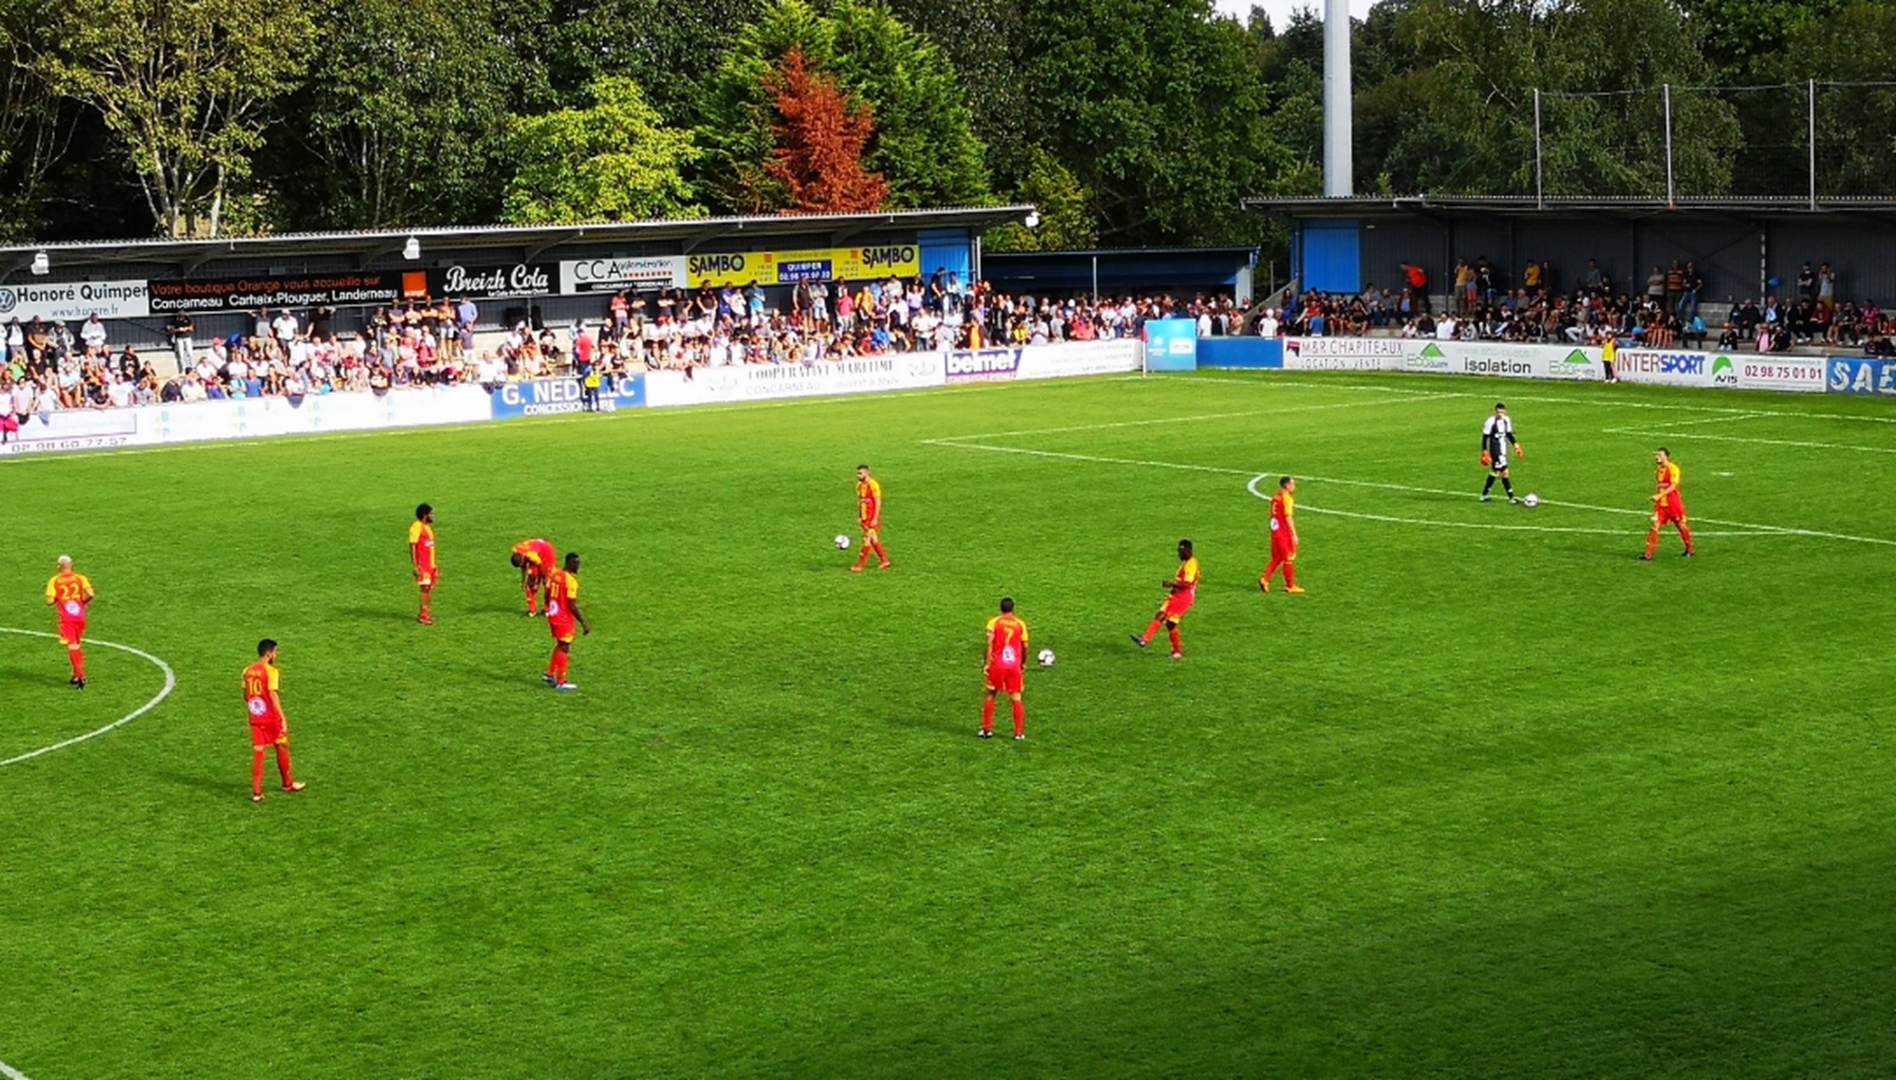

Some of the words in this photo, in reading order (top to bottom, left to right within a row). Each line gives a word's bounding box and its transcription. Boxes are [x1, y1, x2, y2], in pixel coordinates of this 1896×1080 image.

[689, 254, 745, 277] SAMBO
[862, 246, 915, 269] SAMBO
[151, 283, 183, 295] Votre
[185, 282, 235, 294] boutique
[238, 280, 280, 292] Orange
[283, 279, 310, 290] vous
[313, 276, 361, 288] accueille
[363, 276, 381, 286] sur
[443, 265, 506, 292] Breizh
[510, 263, 549, 289] Cola
[17, 284, 75, 302] Honoré
[80, 284, 148, 301] Quimper
[332, 288, 398, 301] Landerneau
[1301, 340, 1326, 354] M&R
[1330, 340, 1404, 355] CHAPITEAUX
[1355, 358, 1381, 370] VENTE
[1464, 357, 1532, 374] isolation
[1617, 352, 1705, 375] INTERSPORT
[1744, 365, 1758, 377] 02
[1761, 365, 1774, 378] 98
[1777, 366, 1790, 378] 75
[1792, 367, 1806, 379] 01
[1809, 367, 1822, 379] 01
[502, 383, 526, 405] G.
[60, 583, 81, 600] 22
[1004, 627, 1014, 645] 7
[247, 677, 262, 695] 10
